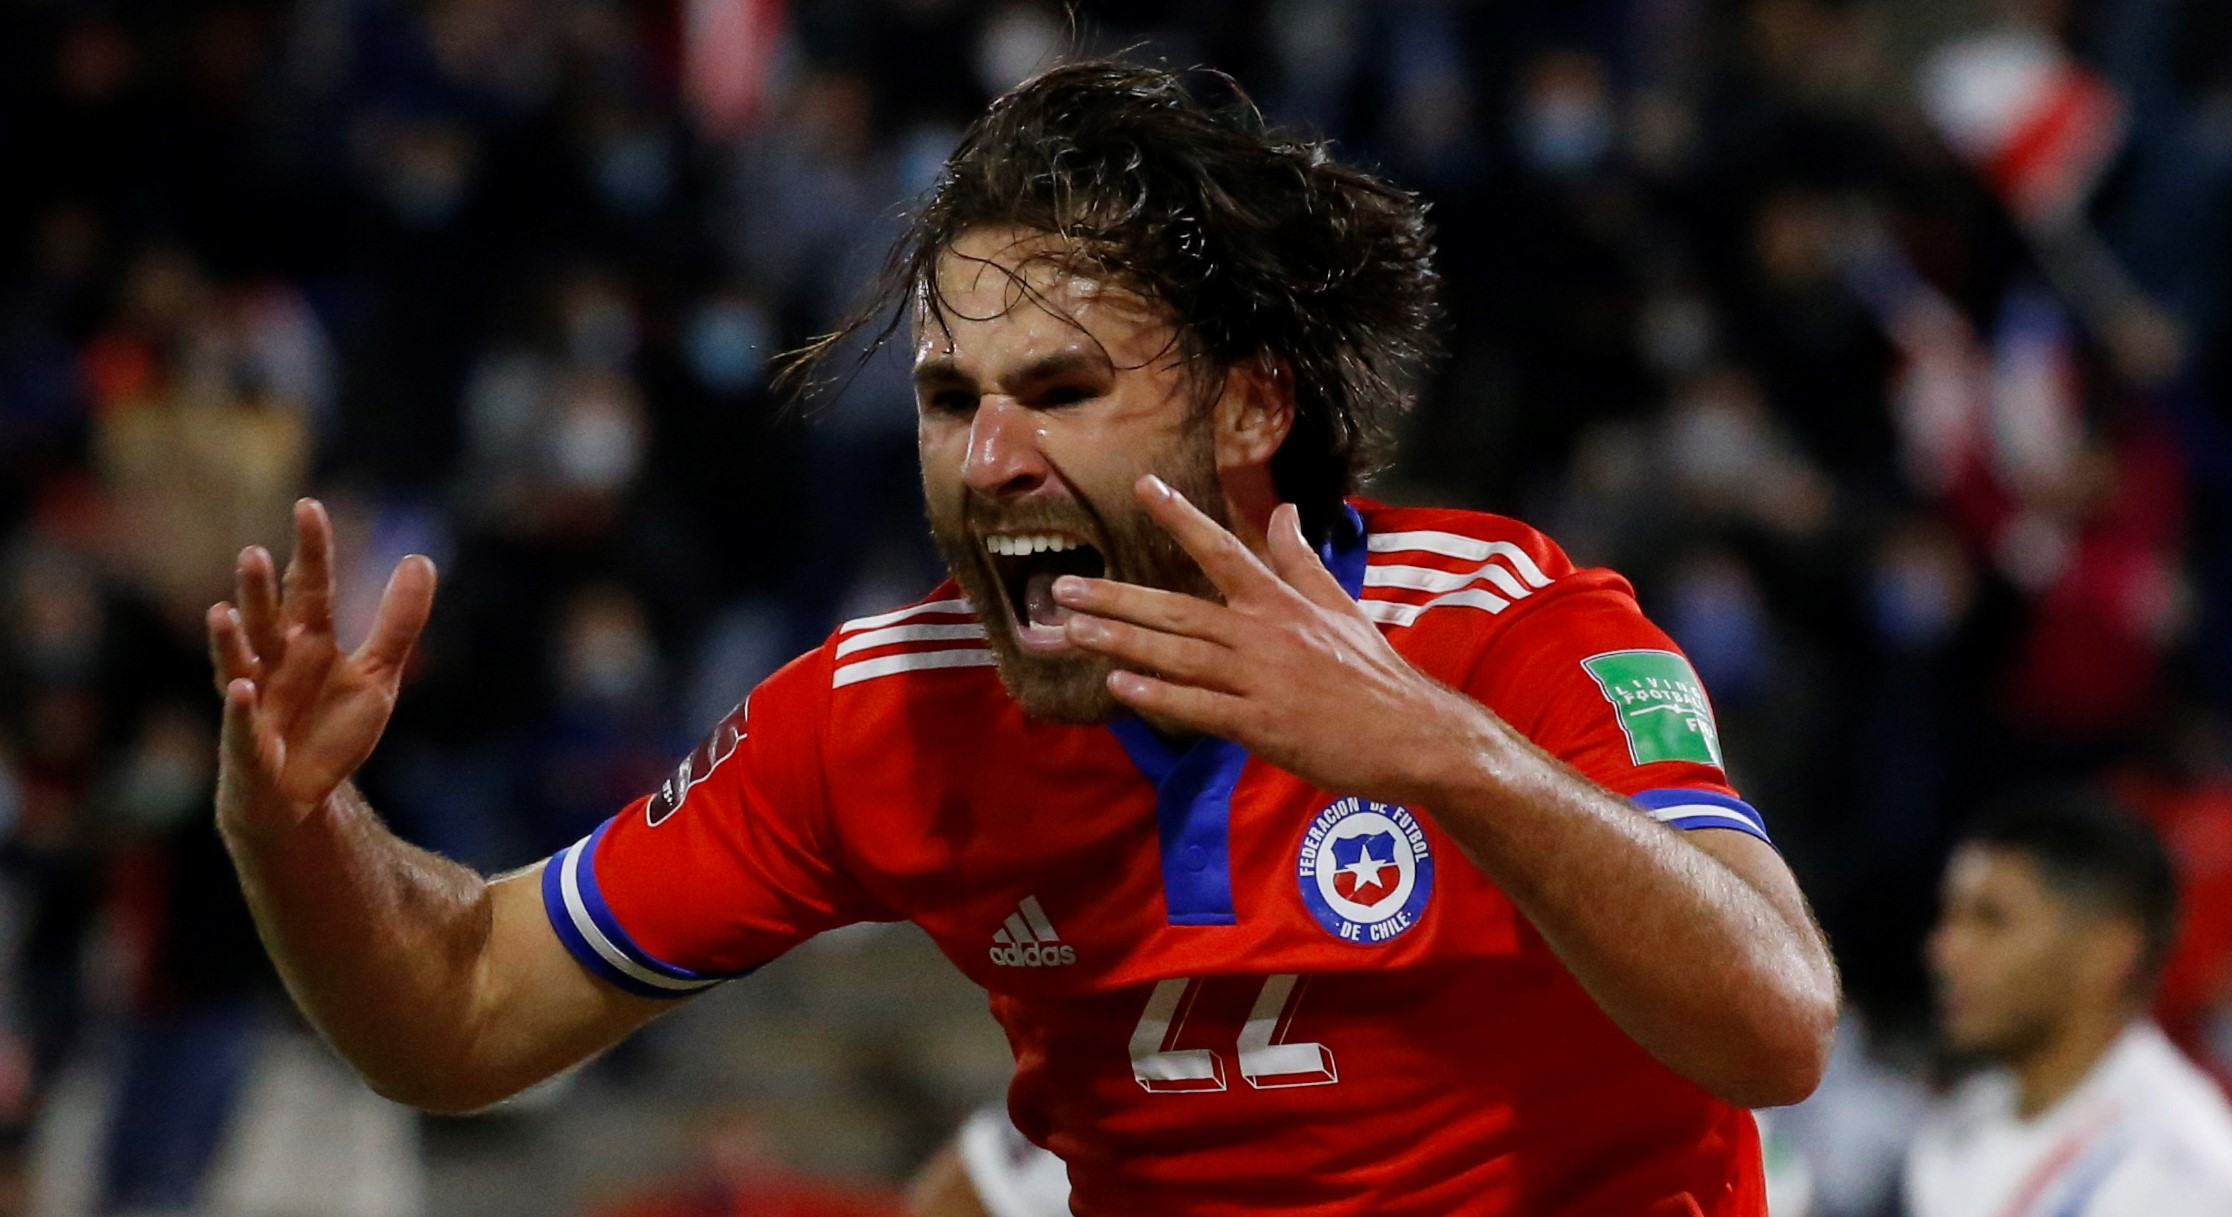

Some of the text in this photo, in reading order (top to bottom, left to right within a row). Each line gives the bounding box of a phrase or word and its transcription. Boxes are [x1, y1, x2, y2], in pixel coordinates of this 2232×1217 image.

[1299, 797, 1428, 876] FEDERACION DE FUTBOL
[1340, 912, 1409, 940] DE CHILE
[989, 941, 1077, 967] adidas
